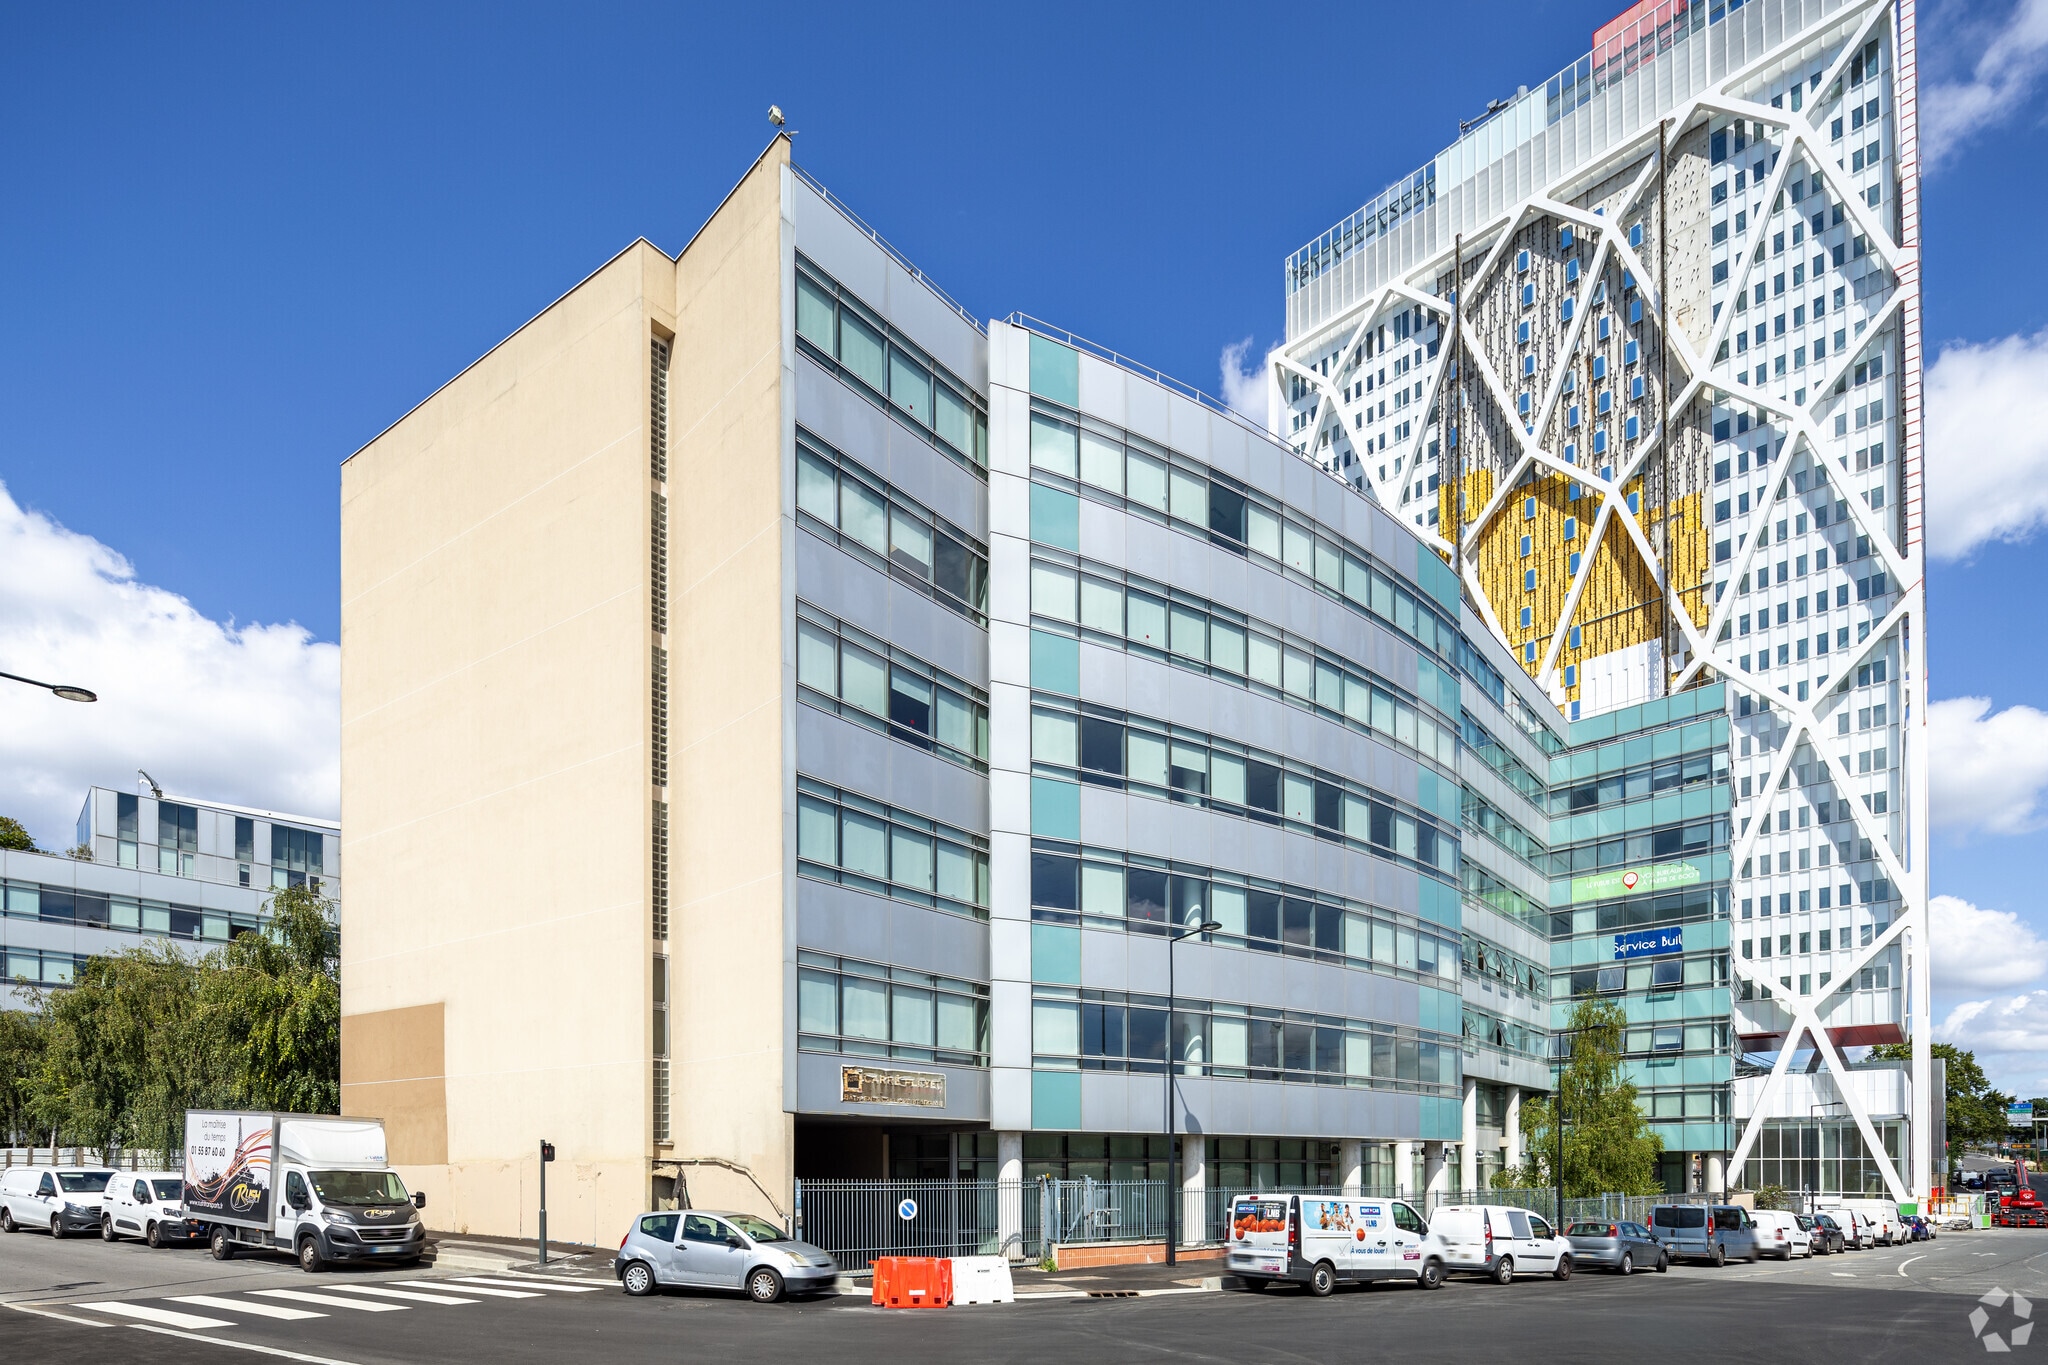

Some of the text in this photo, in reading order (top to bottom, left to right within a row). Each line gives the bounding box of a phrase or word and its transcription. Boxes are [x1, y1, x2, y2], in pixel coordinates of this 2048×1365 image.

[1615, 940, 1657, 953] Service
[209, 1119, 226, 1129] maîtrise
[204, 1133, 226, 1143] du temps
[191, 1145, 225, 1157] 01 55 87 60 60
